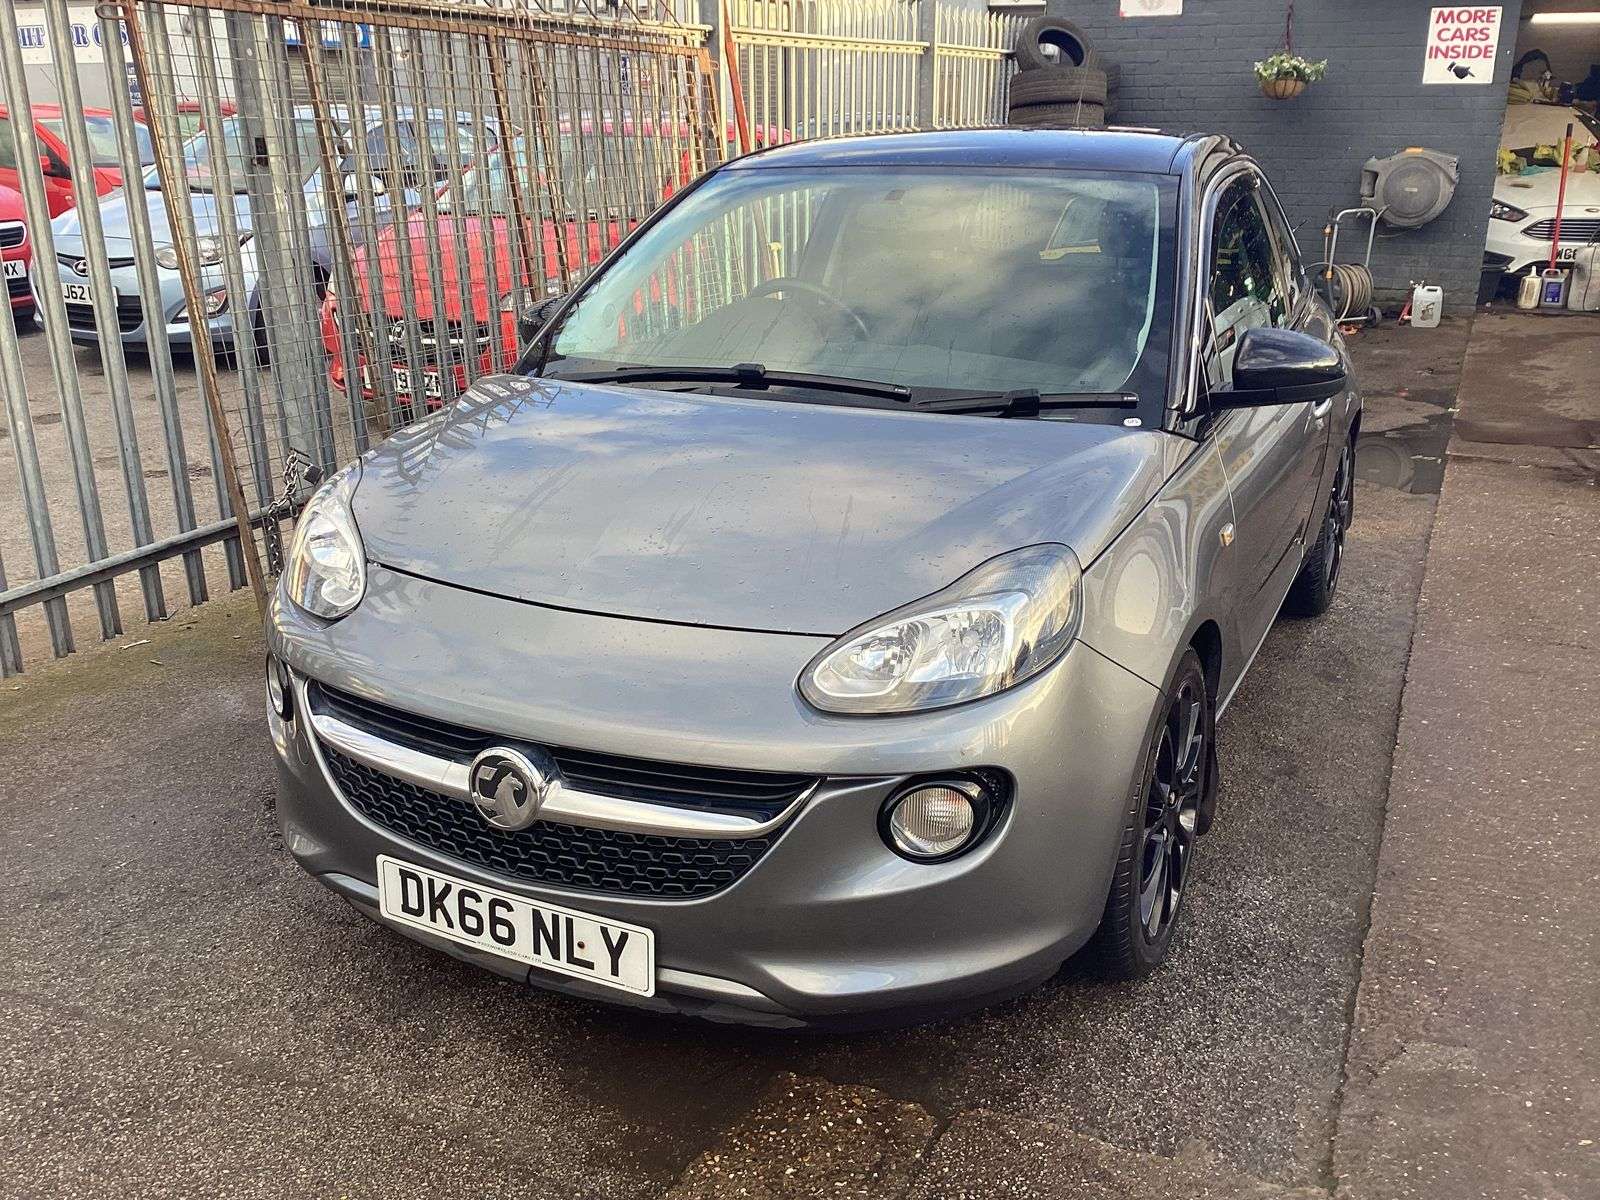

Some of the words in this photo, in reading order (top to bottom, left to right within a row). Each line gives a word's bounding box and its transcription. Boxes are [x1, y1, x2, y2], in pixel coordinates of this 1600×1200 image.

[1436, 9, 1497, 24] MORE
[1437, 27, 1490, 42] CARS
[1429, 44, 1494, 59] INSIDE
[64, 284, 86, 300] J62
[399, 867, 516, 947] DK66
[532, 908, 629, 978] NLY
